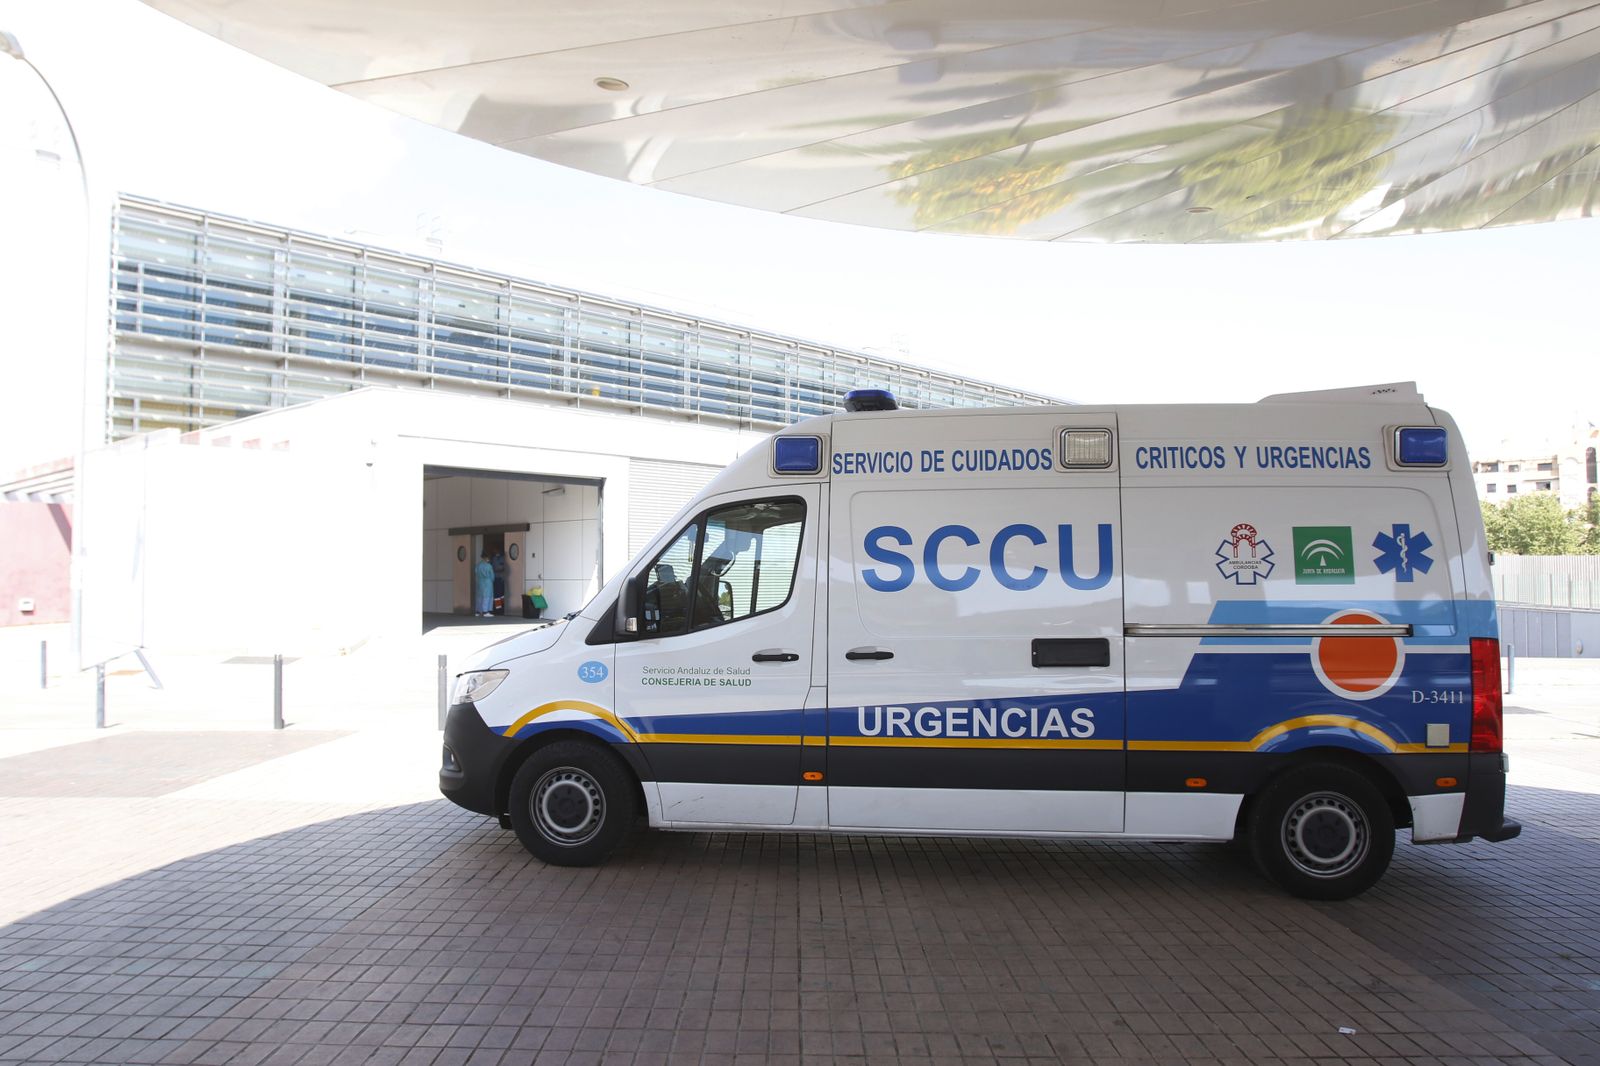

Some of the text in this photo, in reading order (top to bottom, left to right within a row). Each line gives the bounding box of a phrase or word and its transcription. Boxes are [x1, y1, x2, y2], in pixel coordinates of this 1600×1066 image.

[832, 446, 1371, 474] SERVICIO DE CUIDADOS CRITICOS Y URGENCIAS
[861, 523, 1114, 592] SCCU
[581, 666, 604, 679] 354
[642, 666, 751, 676] Servicio Andaluz de Salud
[641, 677, 752, 687] CONSEJERIA DE SALUD
[1411, 690, 1464, 704] D-3411
[858, 706, 1096, 738] URGENCIAS
